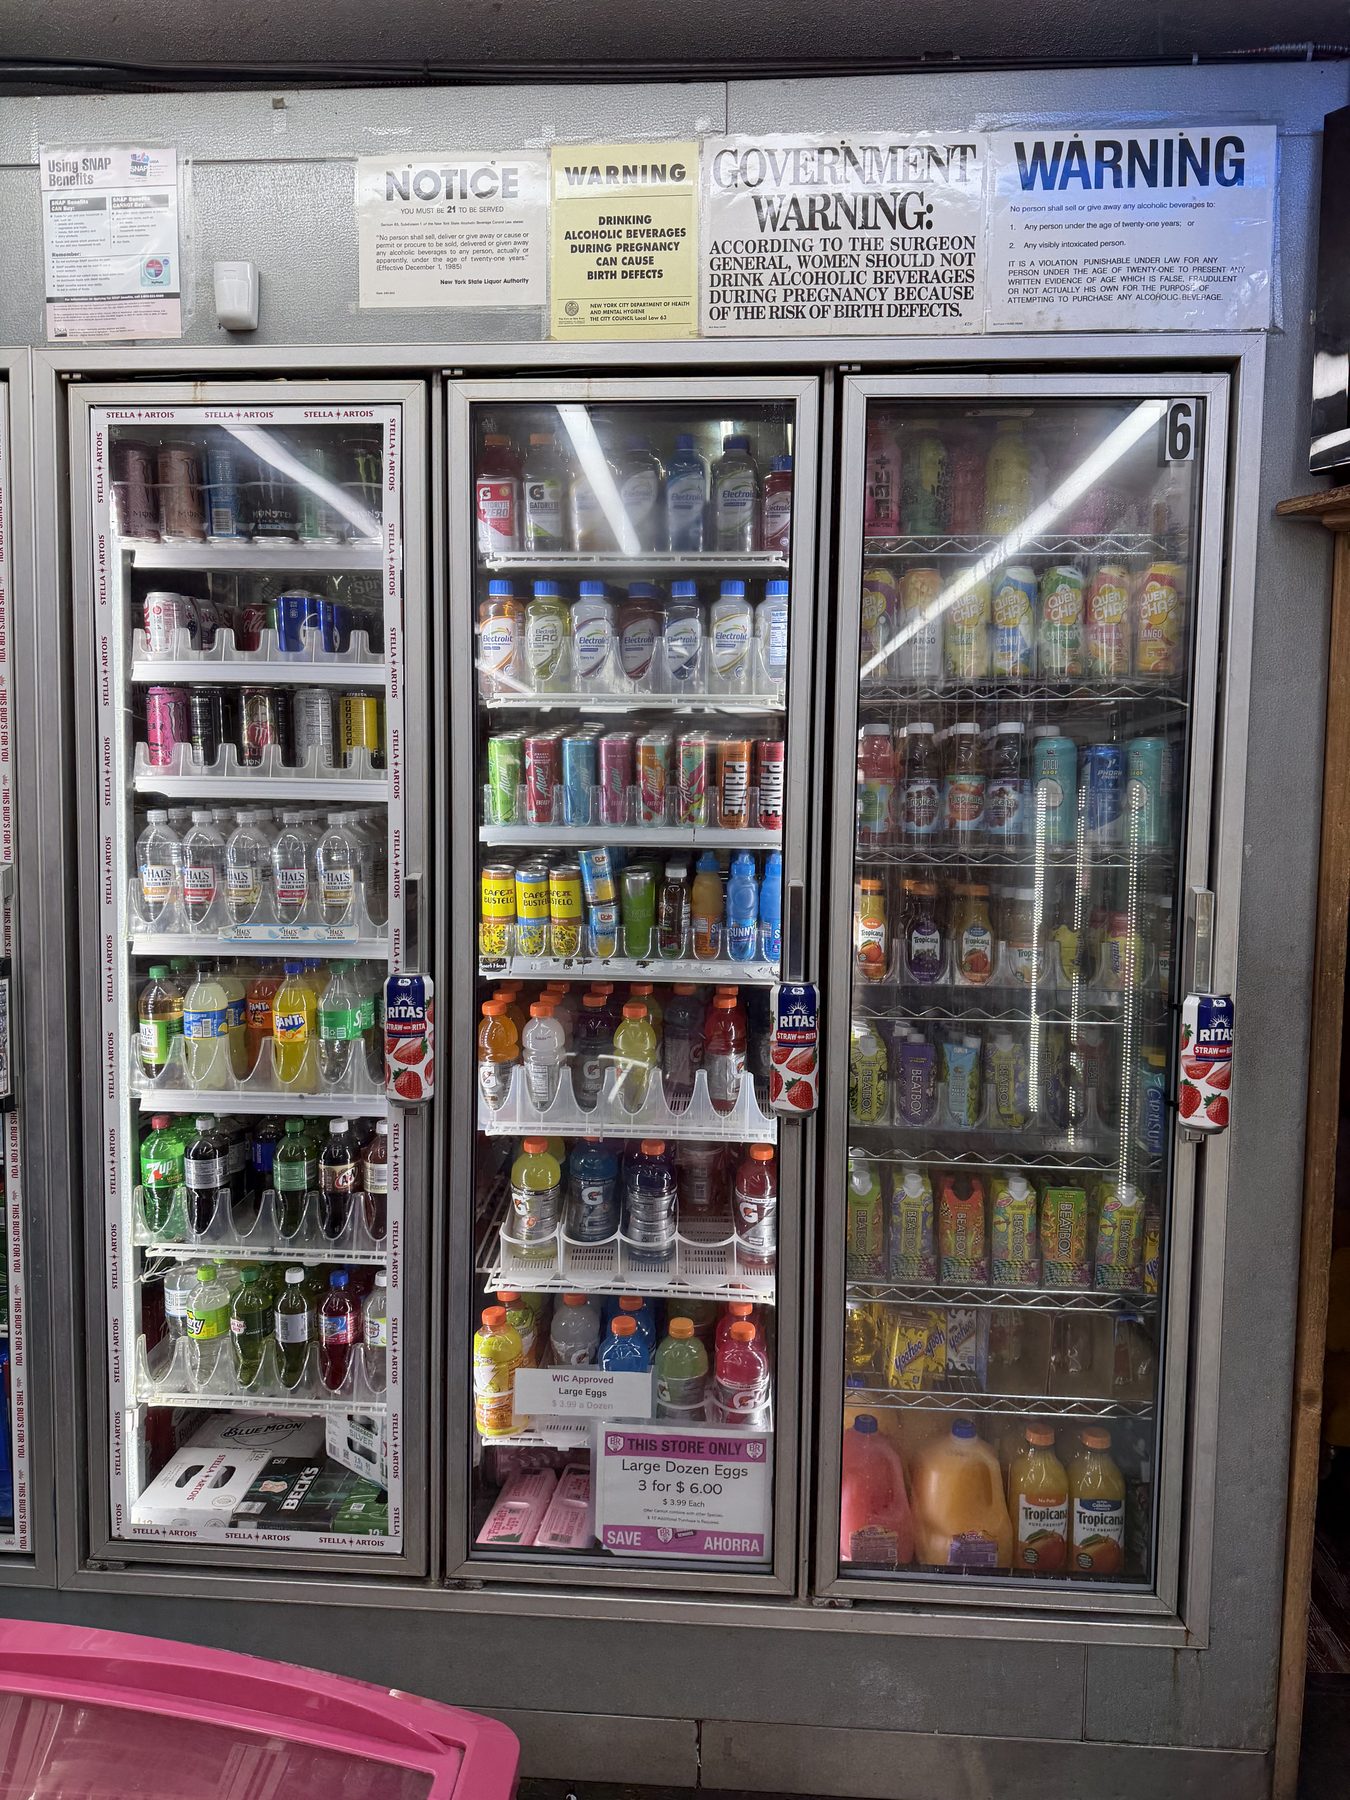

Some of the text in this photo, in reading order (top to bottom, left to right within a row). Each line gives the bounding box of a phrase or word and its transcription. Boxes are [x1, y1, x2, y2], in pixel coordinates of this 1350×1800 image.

[48, 158, 111, 173] Using SNAP
[714, 144, 976, 188] GOVERNMENT
[1014, 136, 1244, 190] WARNING
[49, 173, 94, 186] Benefits
[564, 164, 686, 184] WARNING
[386, 168, 520, 201] NOTICE
[752, 191, 933, 232] WARNING:
[1022, 206, 1046, 214] person
[1087, 204, 1101, 212] give
[1169, 201, 1205, 209] beverages
[599, 215, 652, 225] DRINKING
[564, 228, 686, 240] ALCOHOLIC BEVERAGES
[571, 242, 680, 253] DURING PREGNANCY
[709, 236, 976, 254] ACCORDING TO THE SURGEON
[1024, 242, 1037, 250] Any
[596, 256, 654, 266] CAN CAUSE
[710, 252, 976, 271] GENERAL, WOMEN SHOULD NOT
[588, 269, 663, 280] BIRTH DEFECTS
[710, 269, 974, 287] DRINK ALCOHOLIC BEVERAGES
[709, 286, 974, 304] DURING PREGNANCY BECAUSE
[709, 303, 962, 320] OF THE RISK OF BIRTH DEFECTS.
[1168, 403, 1192, 459] 6
[482, 634, 513, 643] Electrolit
[715, 632, 748, 641] Electrolit
[723, 761, 747, 817] PRIME
[483, 888, 504, 896] CAFE
[483, 896, 514, 904] BUSTELO
[388, 1007, 423, 1018] RITAS
[275, 1014, 305, 1030] FANTA
[780, 1016, 814, 1027] RITAS
[572, 1374, 614, 1384] Approved
[559, 1388, 607, 1398] Large Eggs
[223, 1422, 303, 1437] BLUE MOON
[627, 1438, 742, 1455] THIS STORE ONLY
[622, 1459, 748, 1479] Large Dozen Eggs
[639, 1480, 722, 1495] 3 for $ 6.00
[132, 1528, 160, 1536] STELLA
[607, 1531, 641, 1545] SAVE
[704, 1537, 759, 1552] AHORRA
